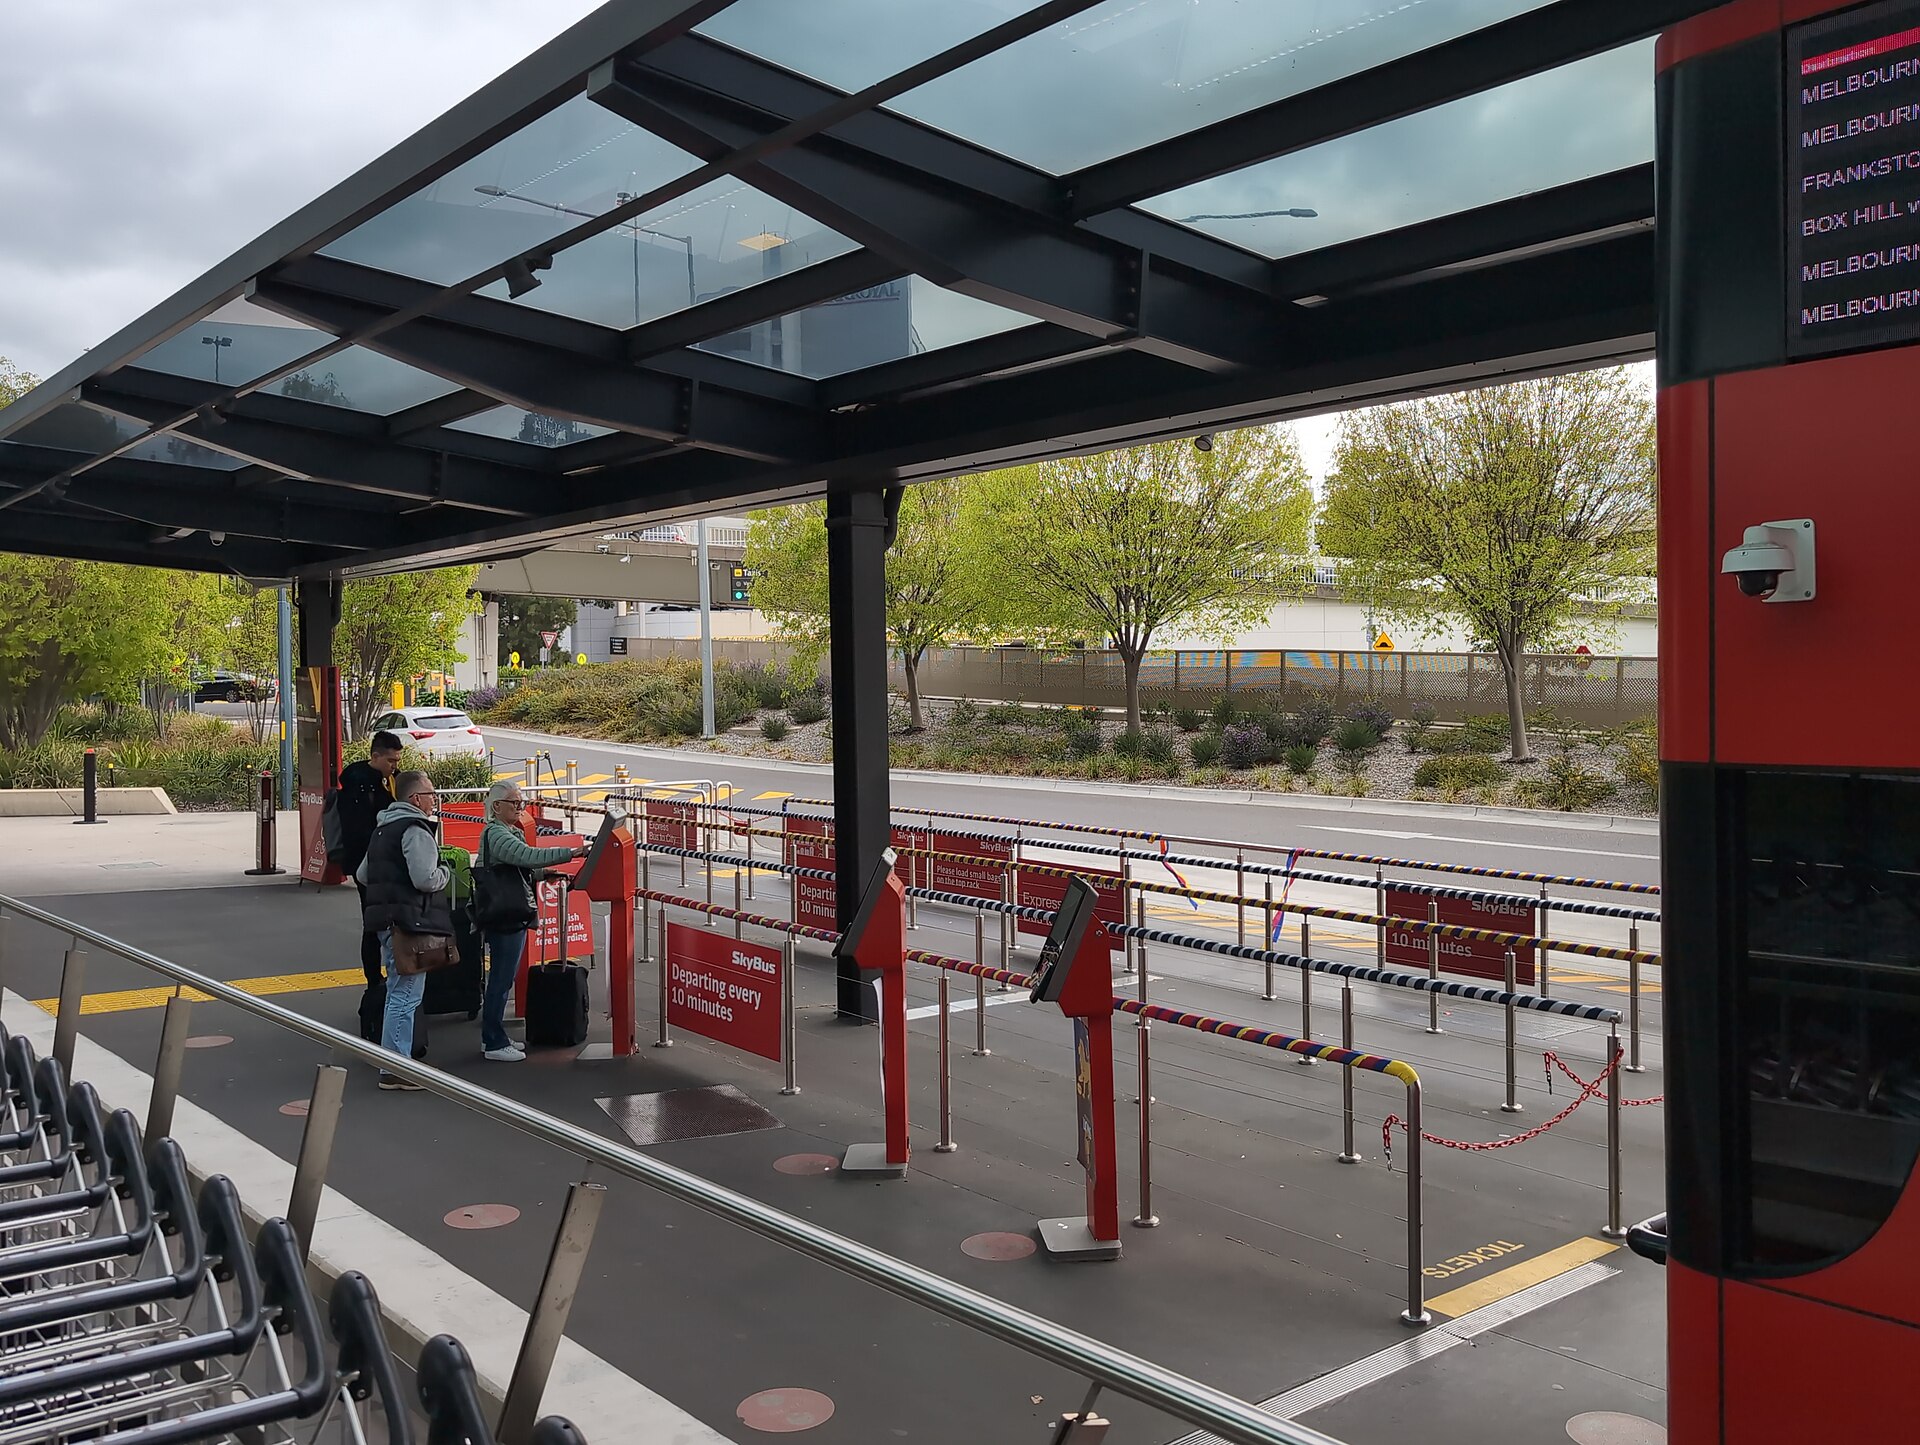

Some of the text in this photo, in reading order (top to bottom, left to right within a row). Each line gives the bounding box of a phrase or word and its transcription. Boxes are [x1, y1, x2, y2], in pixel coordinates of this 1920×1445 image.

[1802, 211, 1848, 236] BOX
[1853, 201, 1904, 225] HILL
[300, 791, 323, 805] SkyBus
[897, 831, 923, 842] Skyus
[980, 841, 1010, 852] SkyBus
[936, 865, 955, 875] Please
[955, 867, 968, 878] load
[969, 870, 986, 880] small
[936, 876, 980, 889] on the top rack
[800, 900, 836, 918] 10 minu
[1023, 892, 1062, 910] Express
[1472, 900, 1528, 916] SkyBus
[547, 926, 558, 935] an
[568, 922, 585, 932] rink
[553, 932, 588, 944] brding
[1391, 932, 1472, 957] 10 miutes
[732, 950, 776, 974] SkyBus
[672, 962, 761, 1011] Departing every
[671, 986, 733, 1022] 10 minutes
[1422, 1240, 1525, 1278] TICKETS
